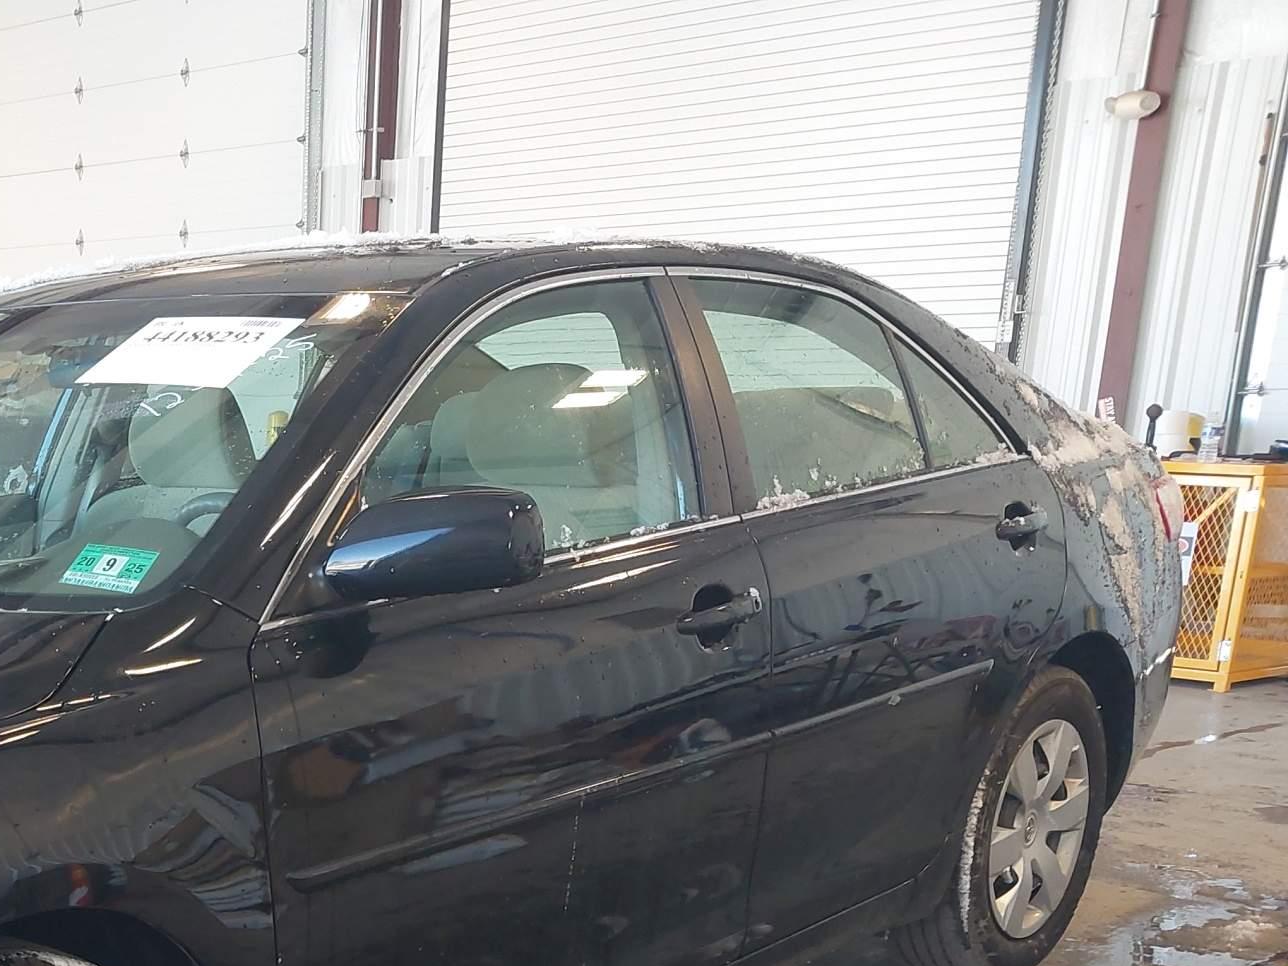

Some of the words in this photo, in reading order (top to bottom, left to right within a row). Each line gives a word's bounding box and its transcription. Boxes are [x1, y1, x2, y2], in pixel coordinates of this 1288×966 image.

[77, 556, 96, 567] 20
[102, 557, 118, 572] 9
[124, 563, 146, 574] 25
